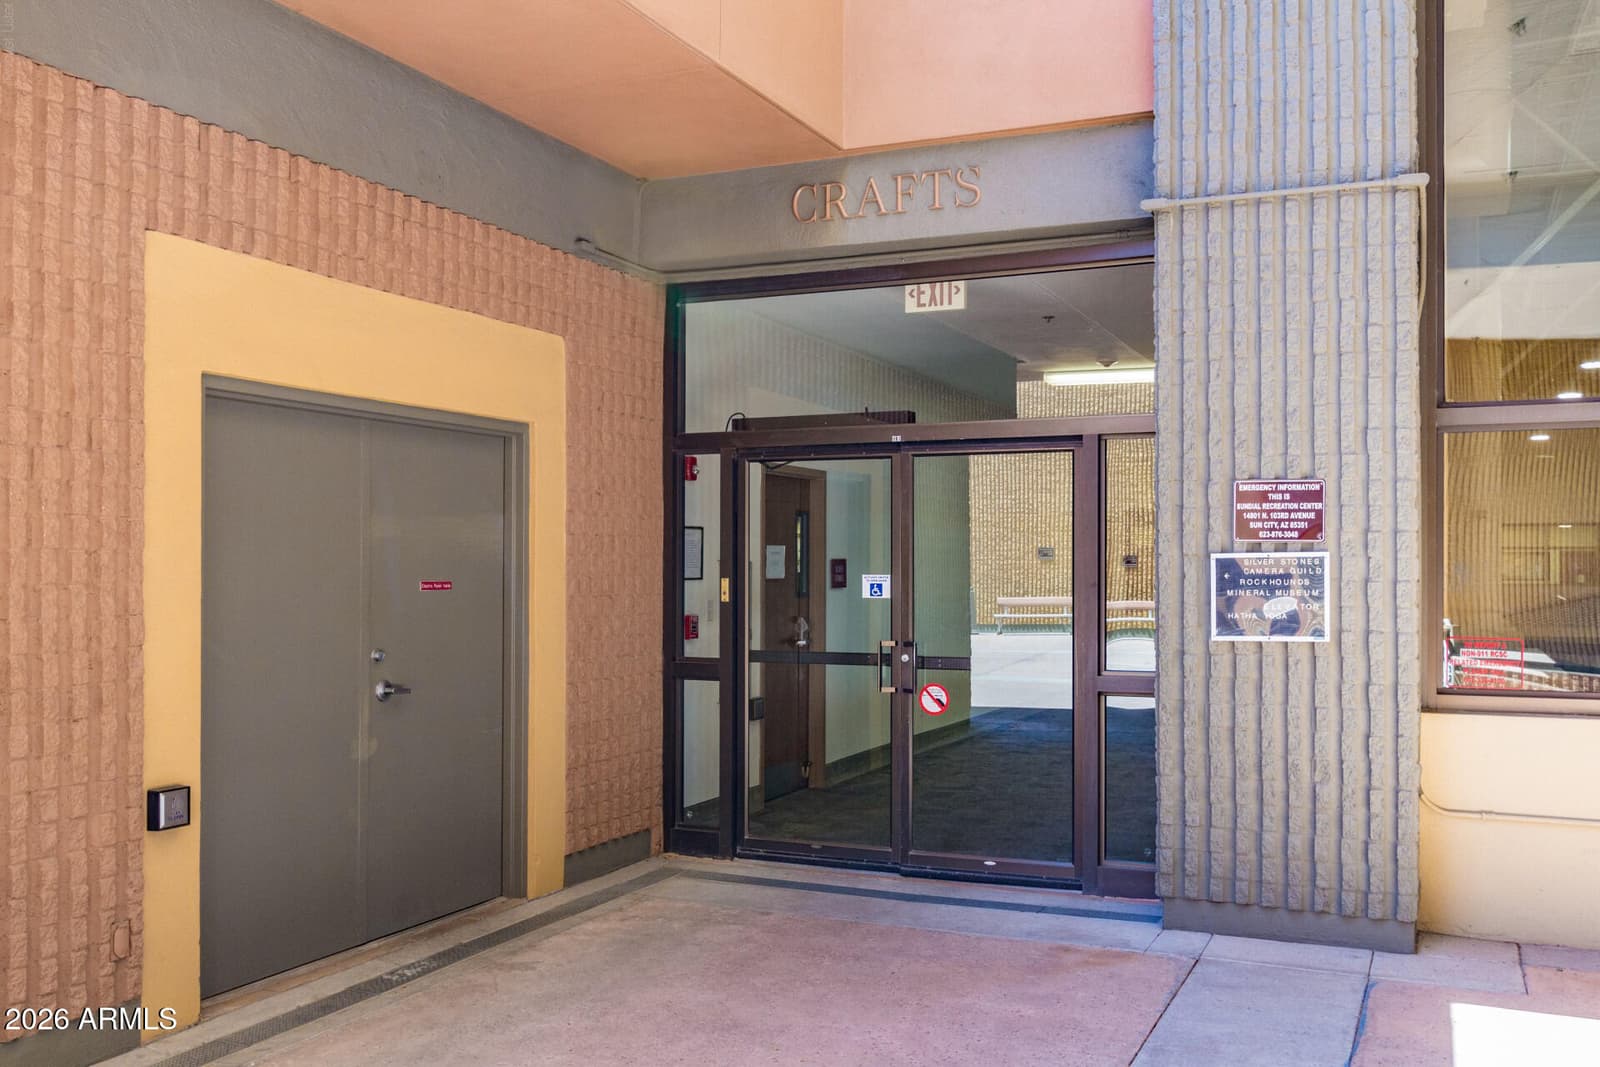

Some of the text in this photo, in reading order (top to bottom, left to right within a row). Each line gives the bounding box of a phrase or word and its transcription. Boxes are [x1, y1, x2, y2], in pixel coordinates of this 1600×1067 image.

[791, 165, 982, 224] CRAFTS
[1239, 483, 1320, 491] EMERGENCY INFORMATION
[1262, 502, 1298, 510] RECREATION
[1263, 521, 1279, 529] CITY,
[1243, 567, 1322, 575] CAMERA GUILD
[1226, 589, 1320, 597] MINERAL MUSEUM
